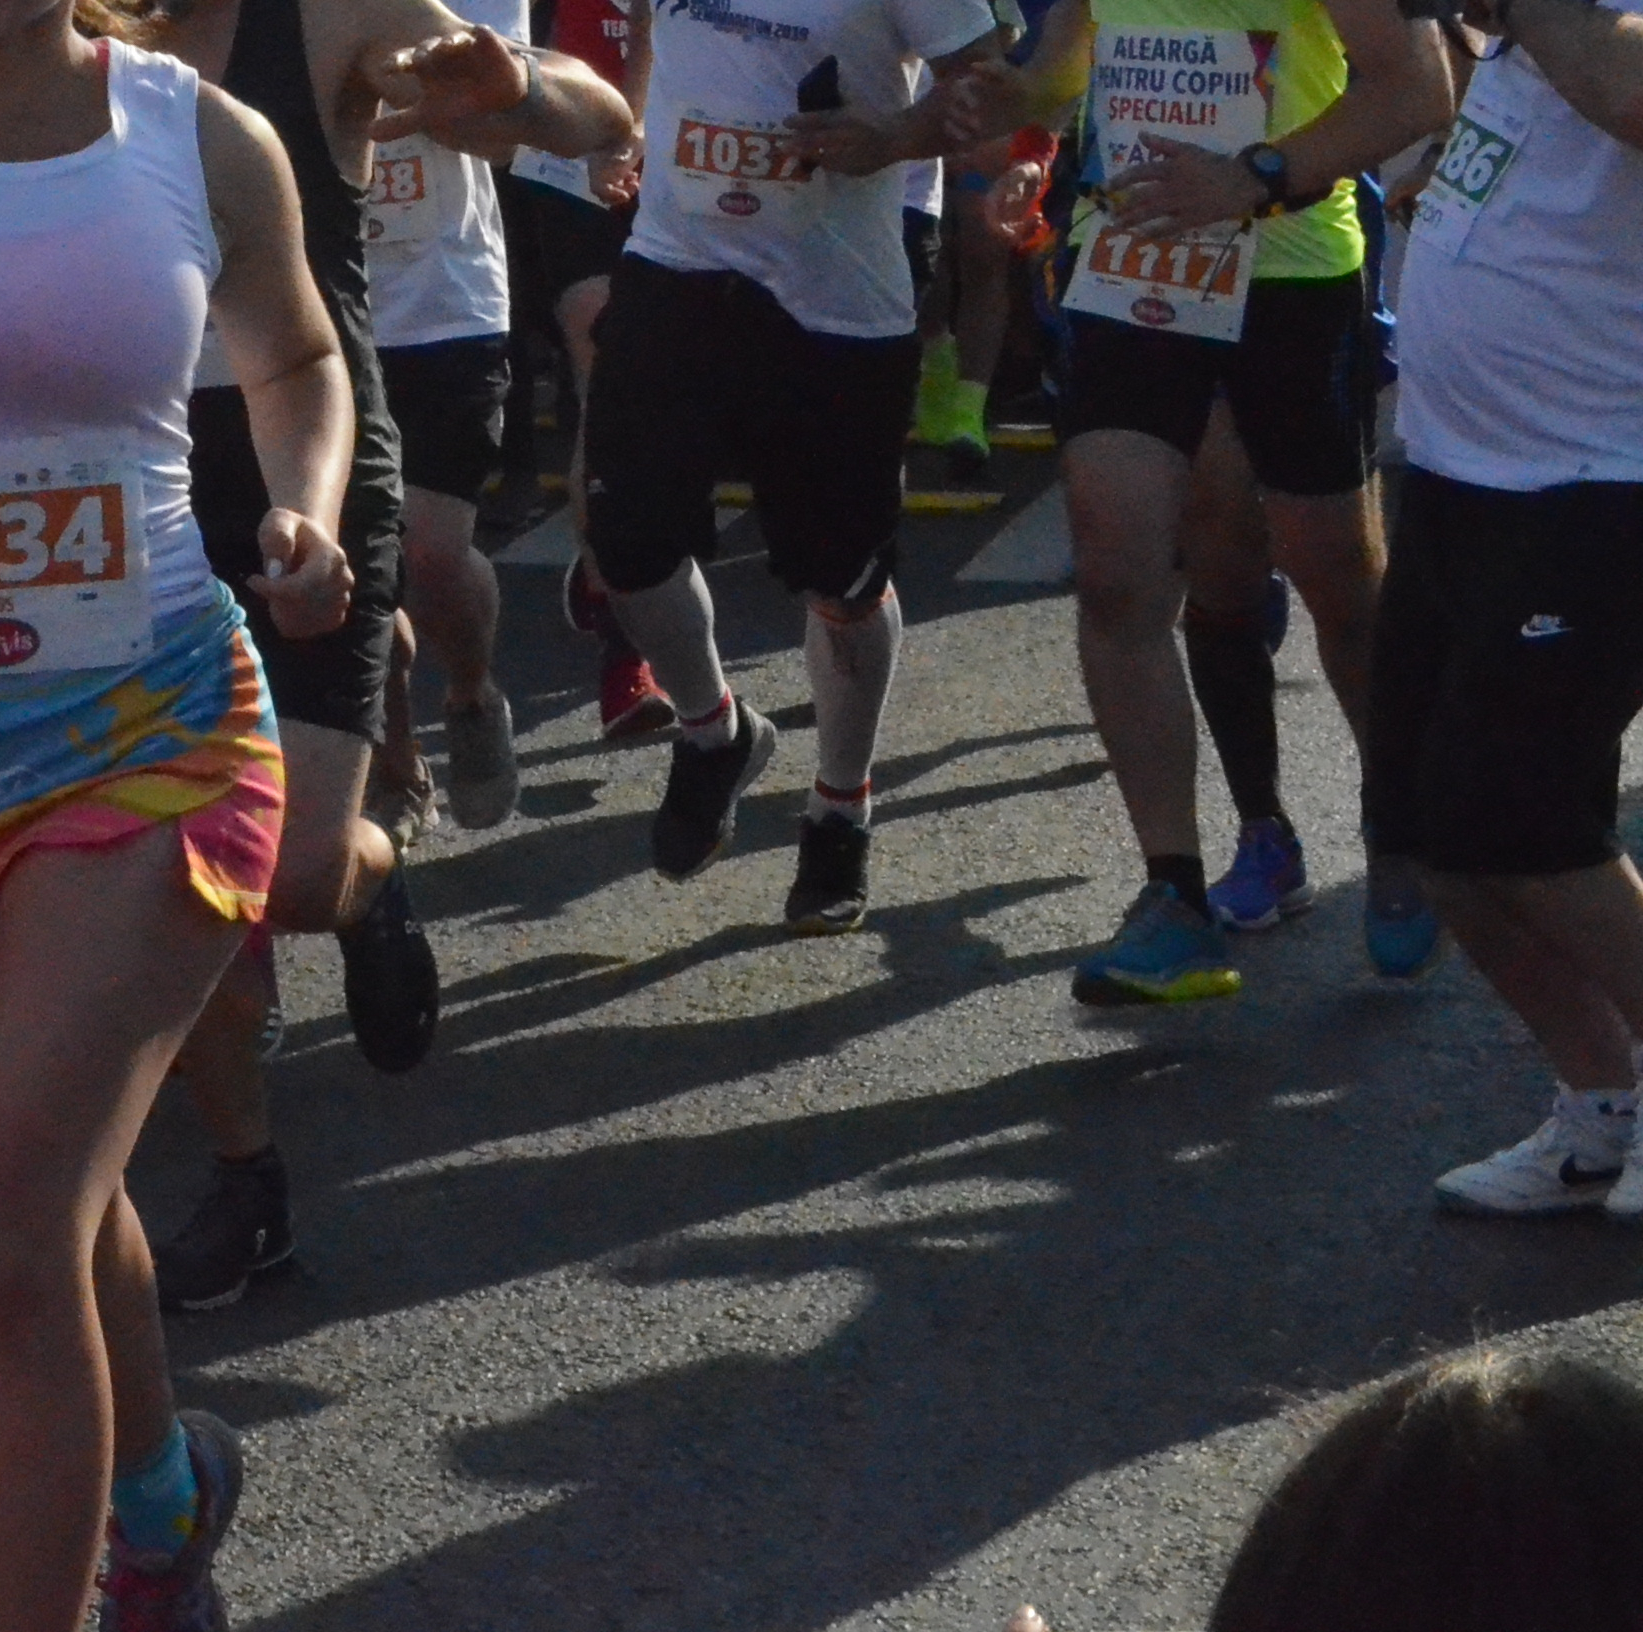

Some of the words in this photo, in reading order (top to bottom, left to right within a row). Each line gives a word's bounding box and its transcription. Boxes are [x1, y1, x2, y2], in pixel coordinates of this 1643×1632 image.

[1113, 34, 1218, 65] ALEARGĂ
[1108, 95, 1218, 126] SPECIALI!
[1105, 233, 1232, 291] 1117
